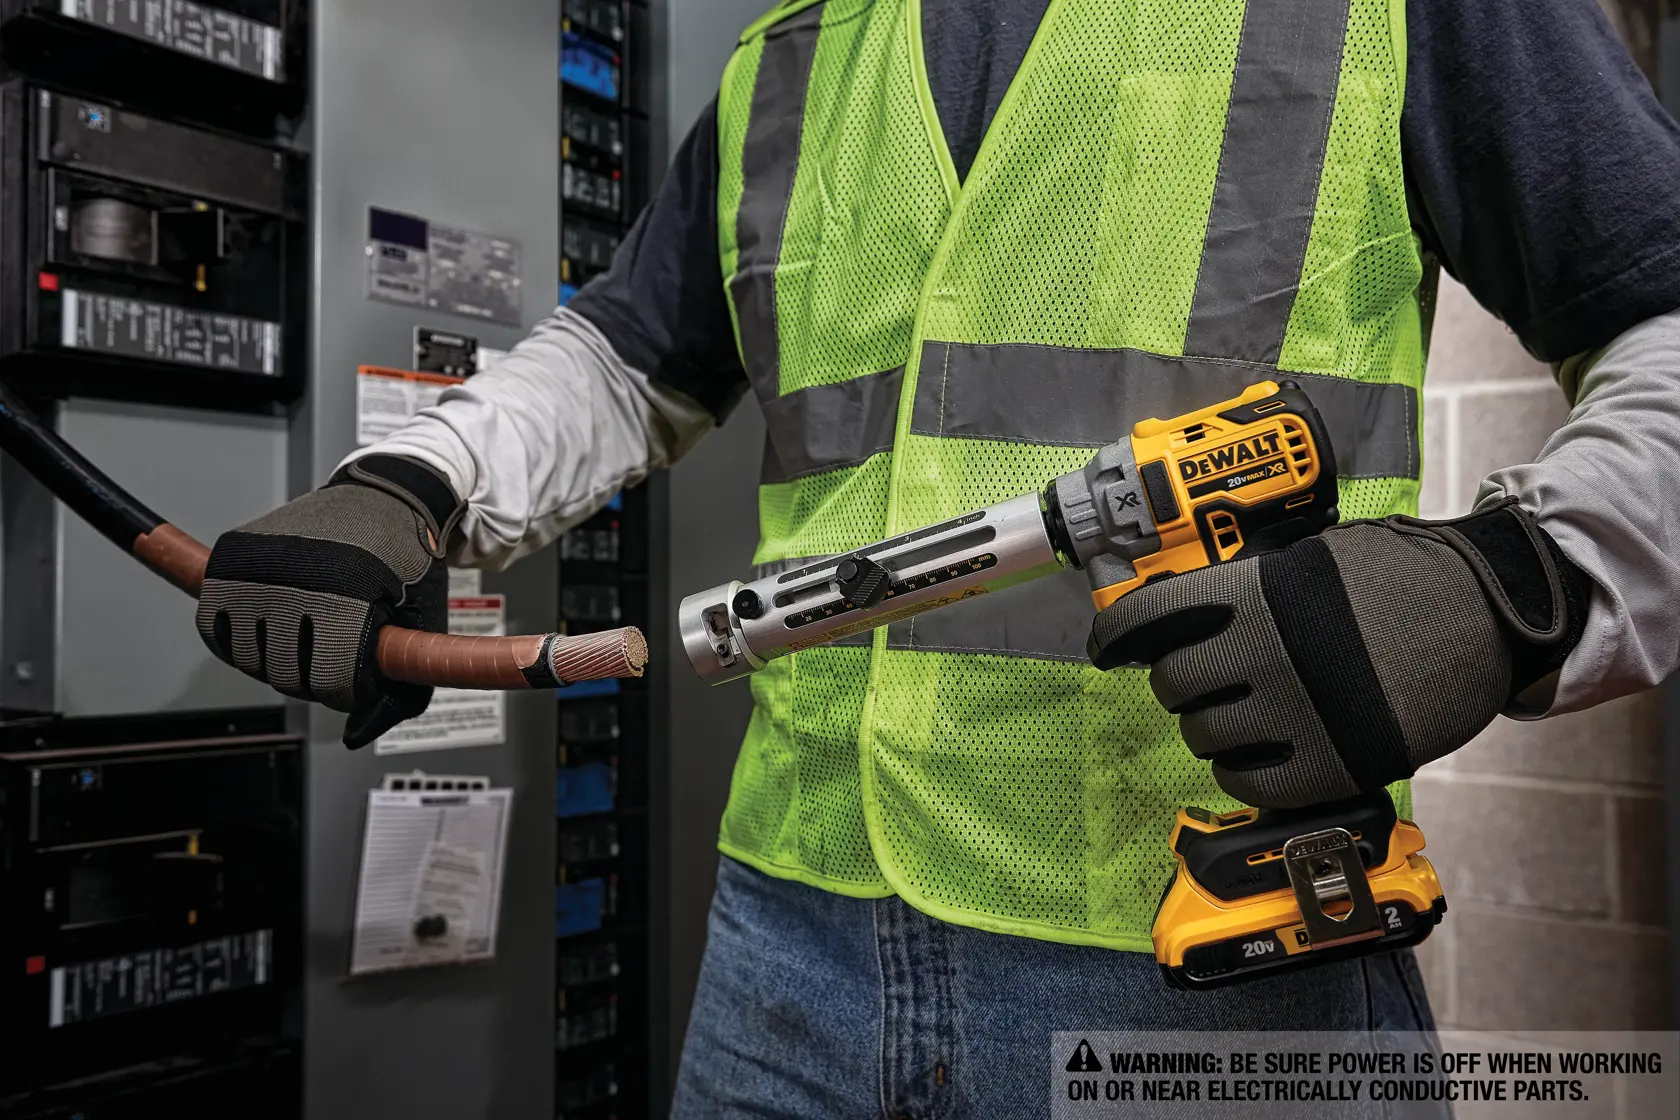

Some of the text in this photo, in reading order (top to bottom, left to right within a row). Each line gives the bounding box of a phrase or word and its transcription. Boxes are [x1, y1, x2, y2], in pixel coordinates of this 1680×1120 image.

[1178, 433, 1281, 480] DEWALT
[1114, 491, 1142, 512] XR
[966, 514, 981, 522] inch
[978, 554, 992, 562] mm
[1384, 906, 1401, 924] 2
